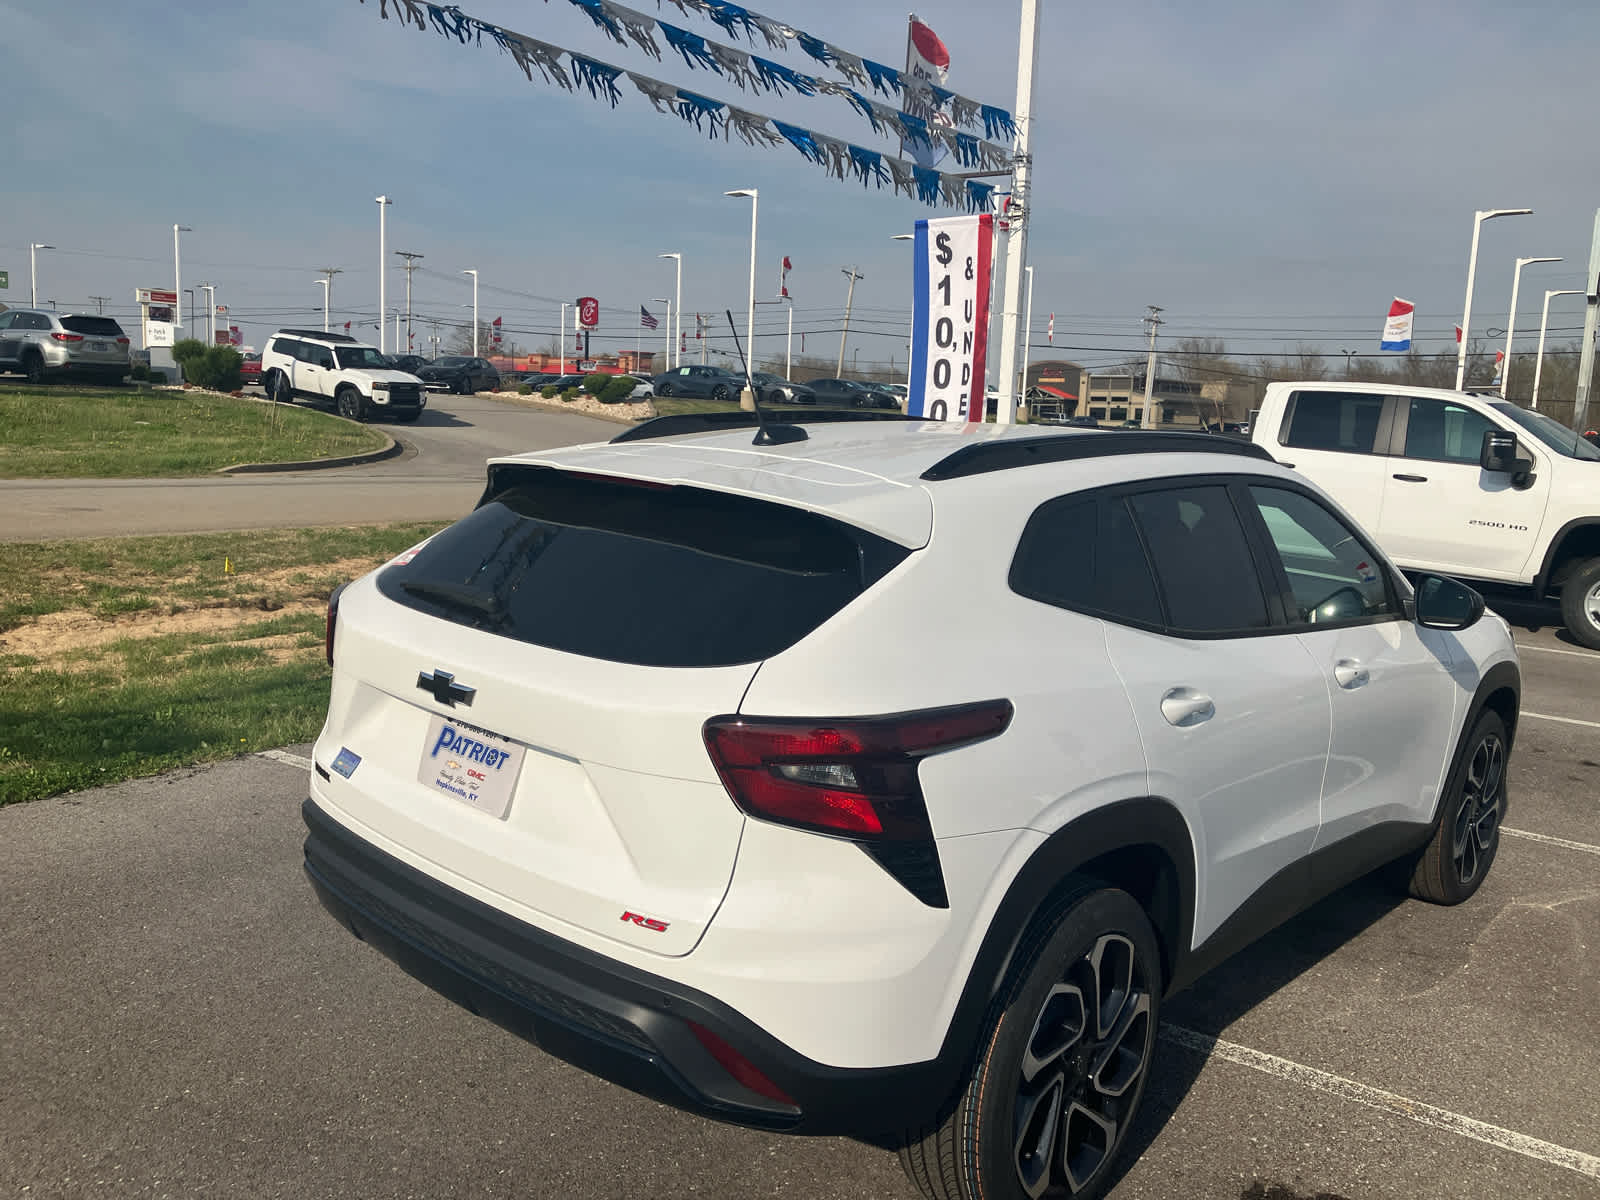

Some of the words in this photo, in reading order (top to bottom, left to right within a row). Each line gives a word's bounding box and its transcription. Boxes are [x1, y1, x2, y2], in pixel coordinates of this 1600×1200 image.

[964, 256, 974, 281] &
[1468, 519, 1505, 529] 2500
[1509, 523, 1528, 531] HD
[431, 724, 511, 770] PATRIOT
[466, 768, 486, 782] GMC
[435, 777, 468, 799] Hopkinsville,
[468, 792, 479, 801] KY
[620, 910, 671, 932] RS
